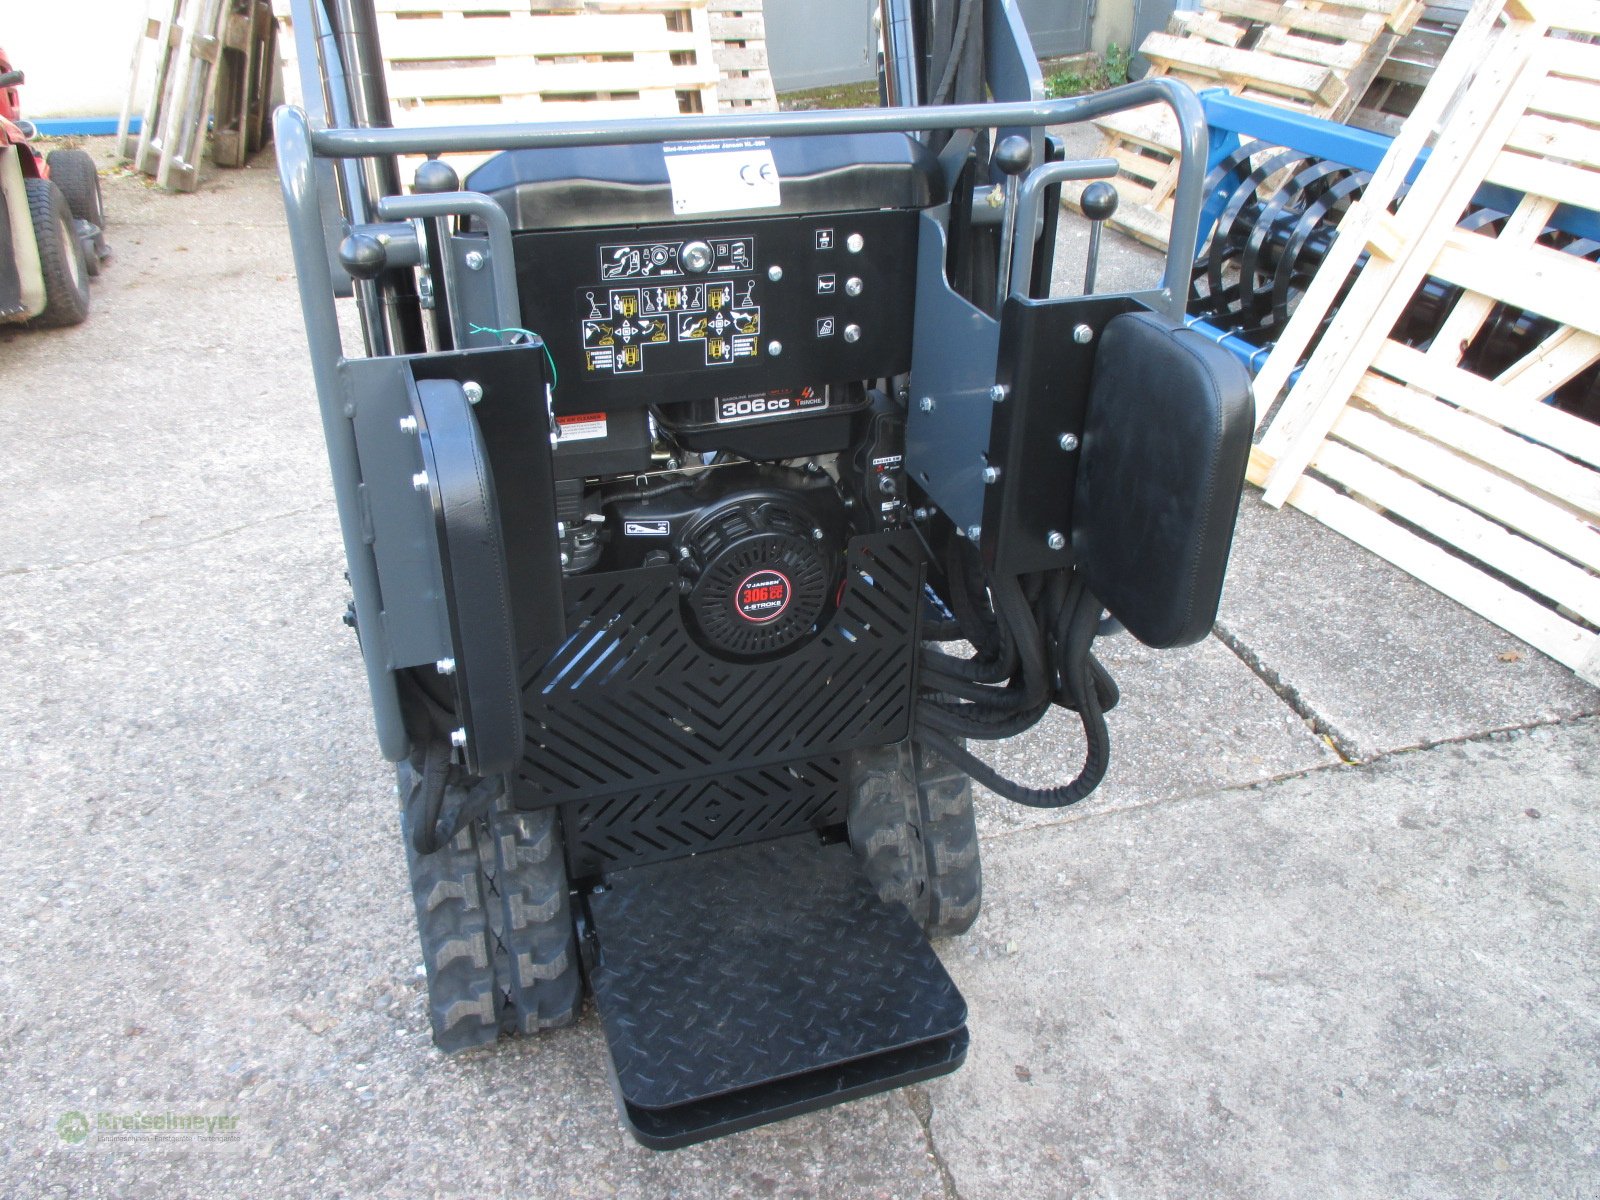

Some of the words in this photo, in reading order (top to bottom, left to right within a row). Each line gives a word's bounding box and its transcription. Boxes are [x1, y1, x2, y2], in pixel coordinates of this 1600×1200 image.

[722, 398, 765, 417] 306
[767, 398, 790, 410] cc
[743, 587, 769, 604] 306
[743, 600, 782, 610] 4-STROKE
